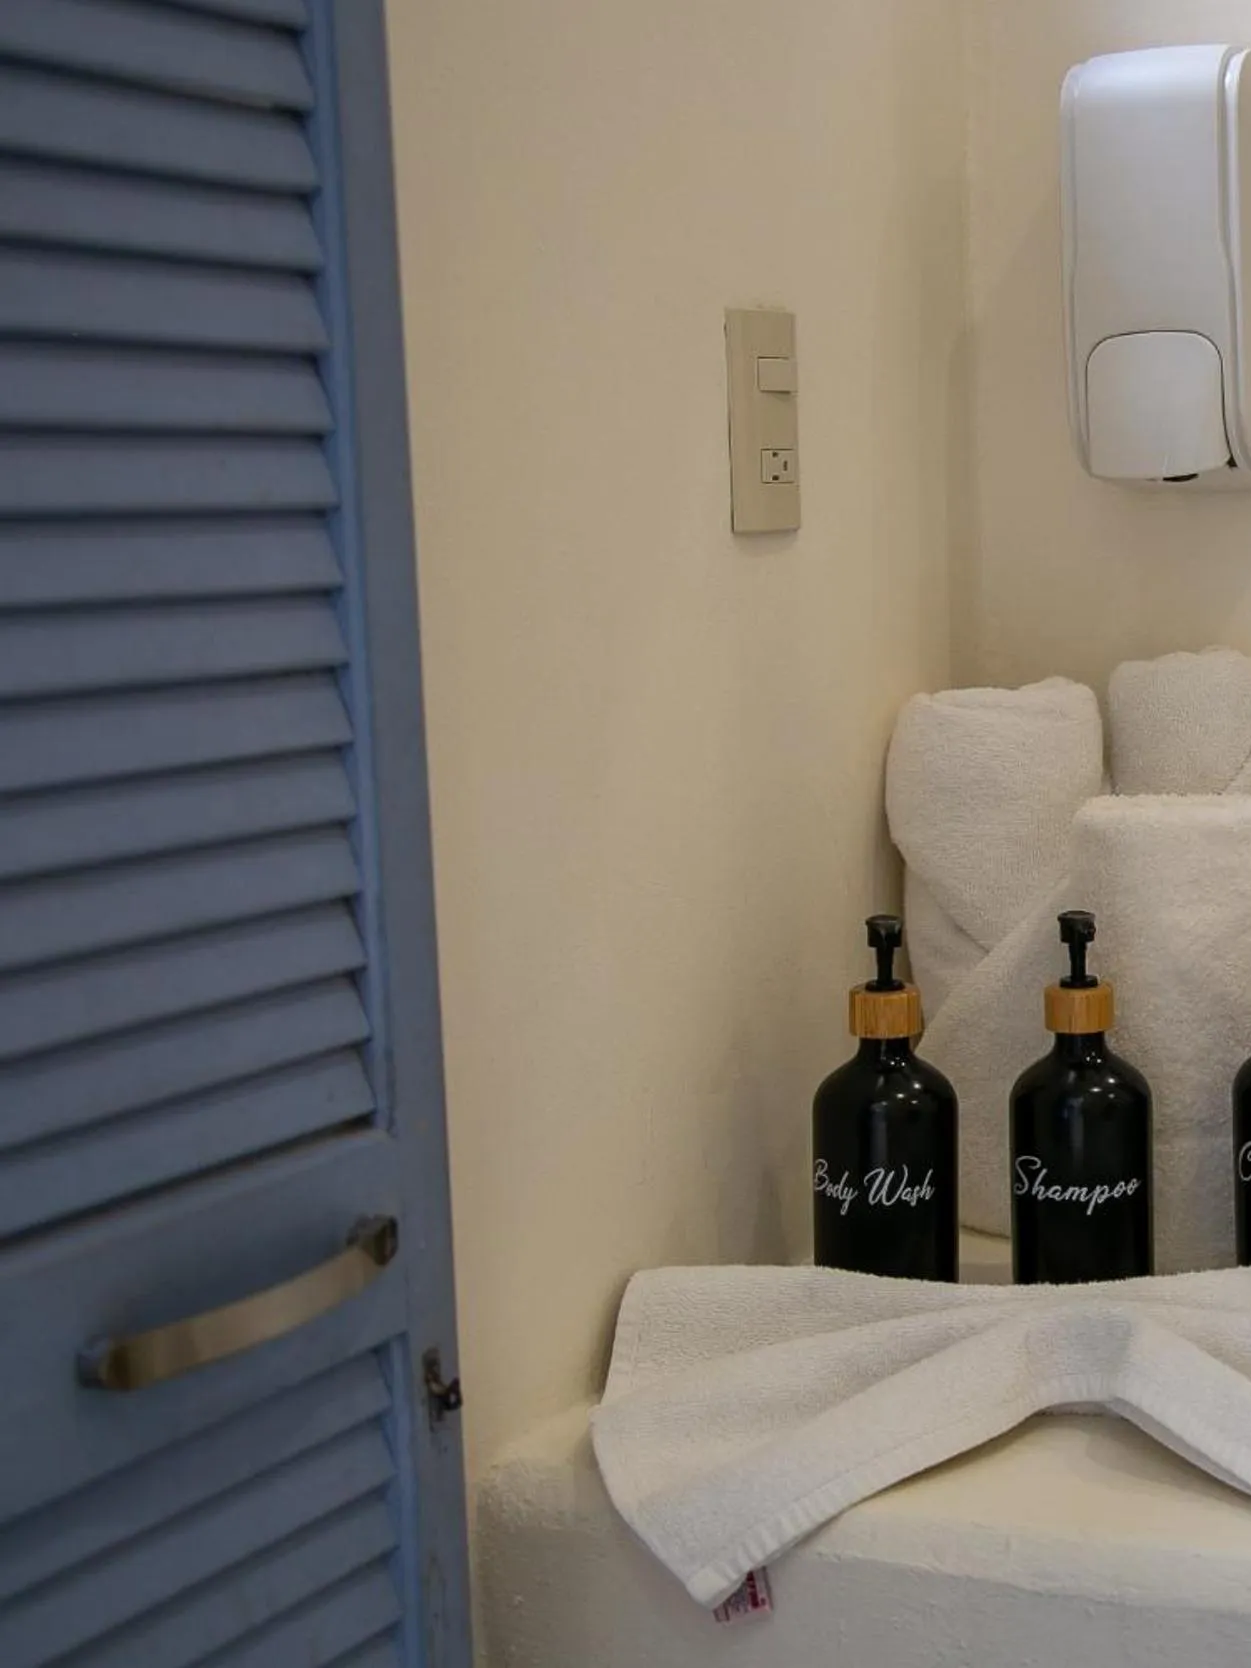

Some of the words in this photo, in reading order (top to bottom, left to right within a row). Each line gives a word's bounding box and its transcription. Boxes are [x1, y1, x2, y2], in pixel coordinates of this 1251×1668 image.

[814, 1158, 858, 1216] Body
[863, 1164, 934, 1208] Wash
[1014, 1155, 1141, 1216] Shampoo
